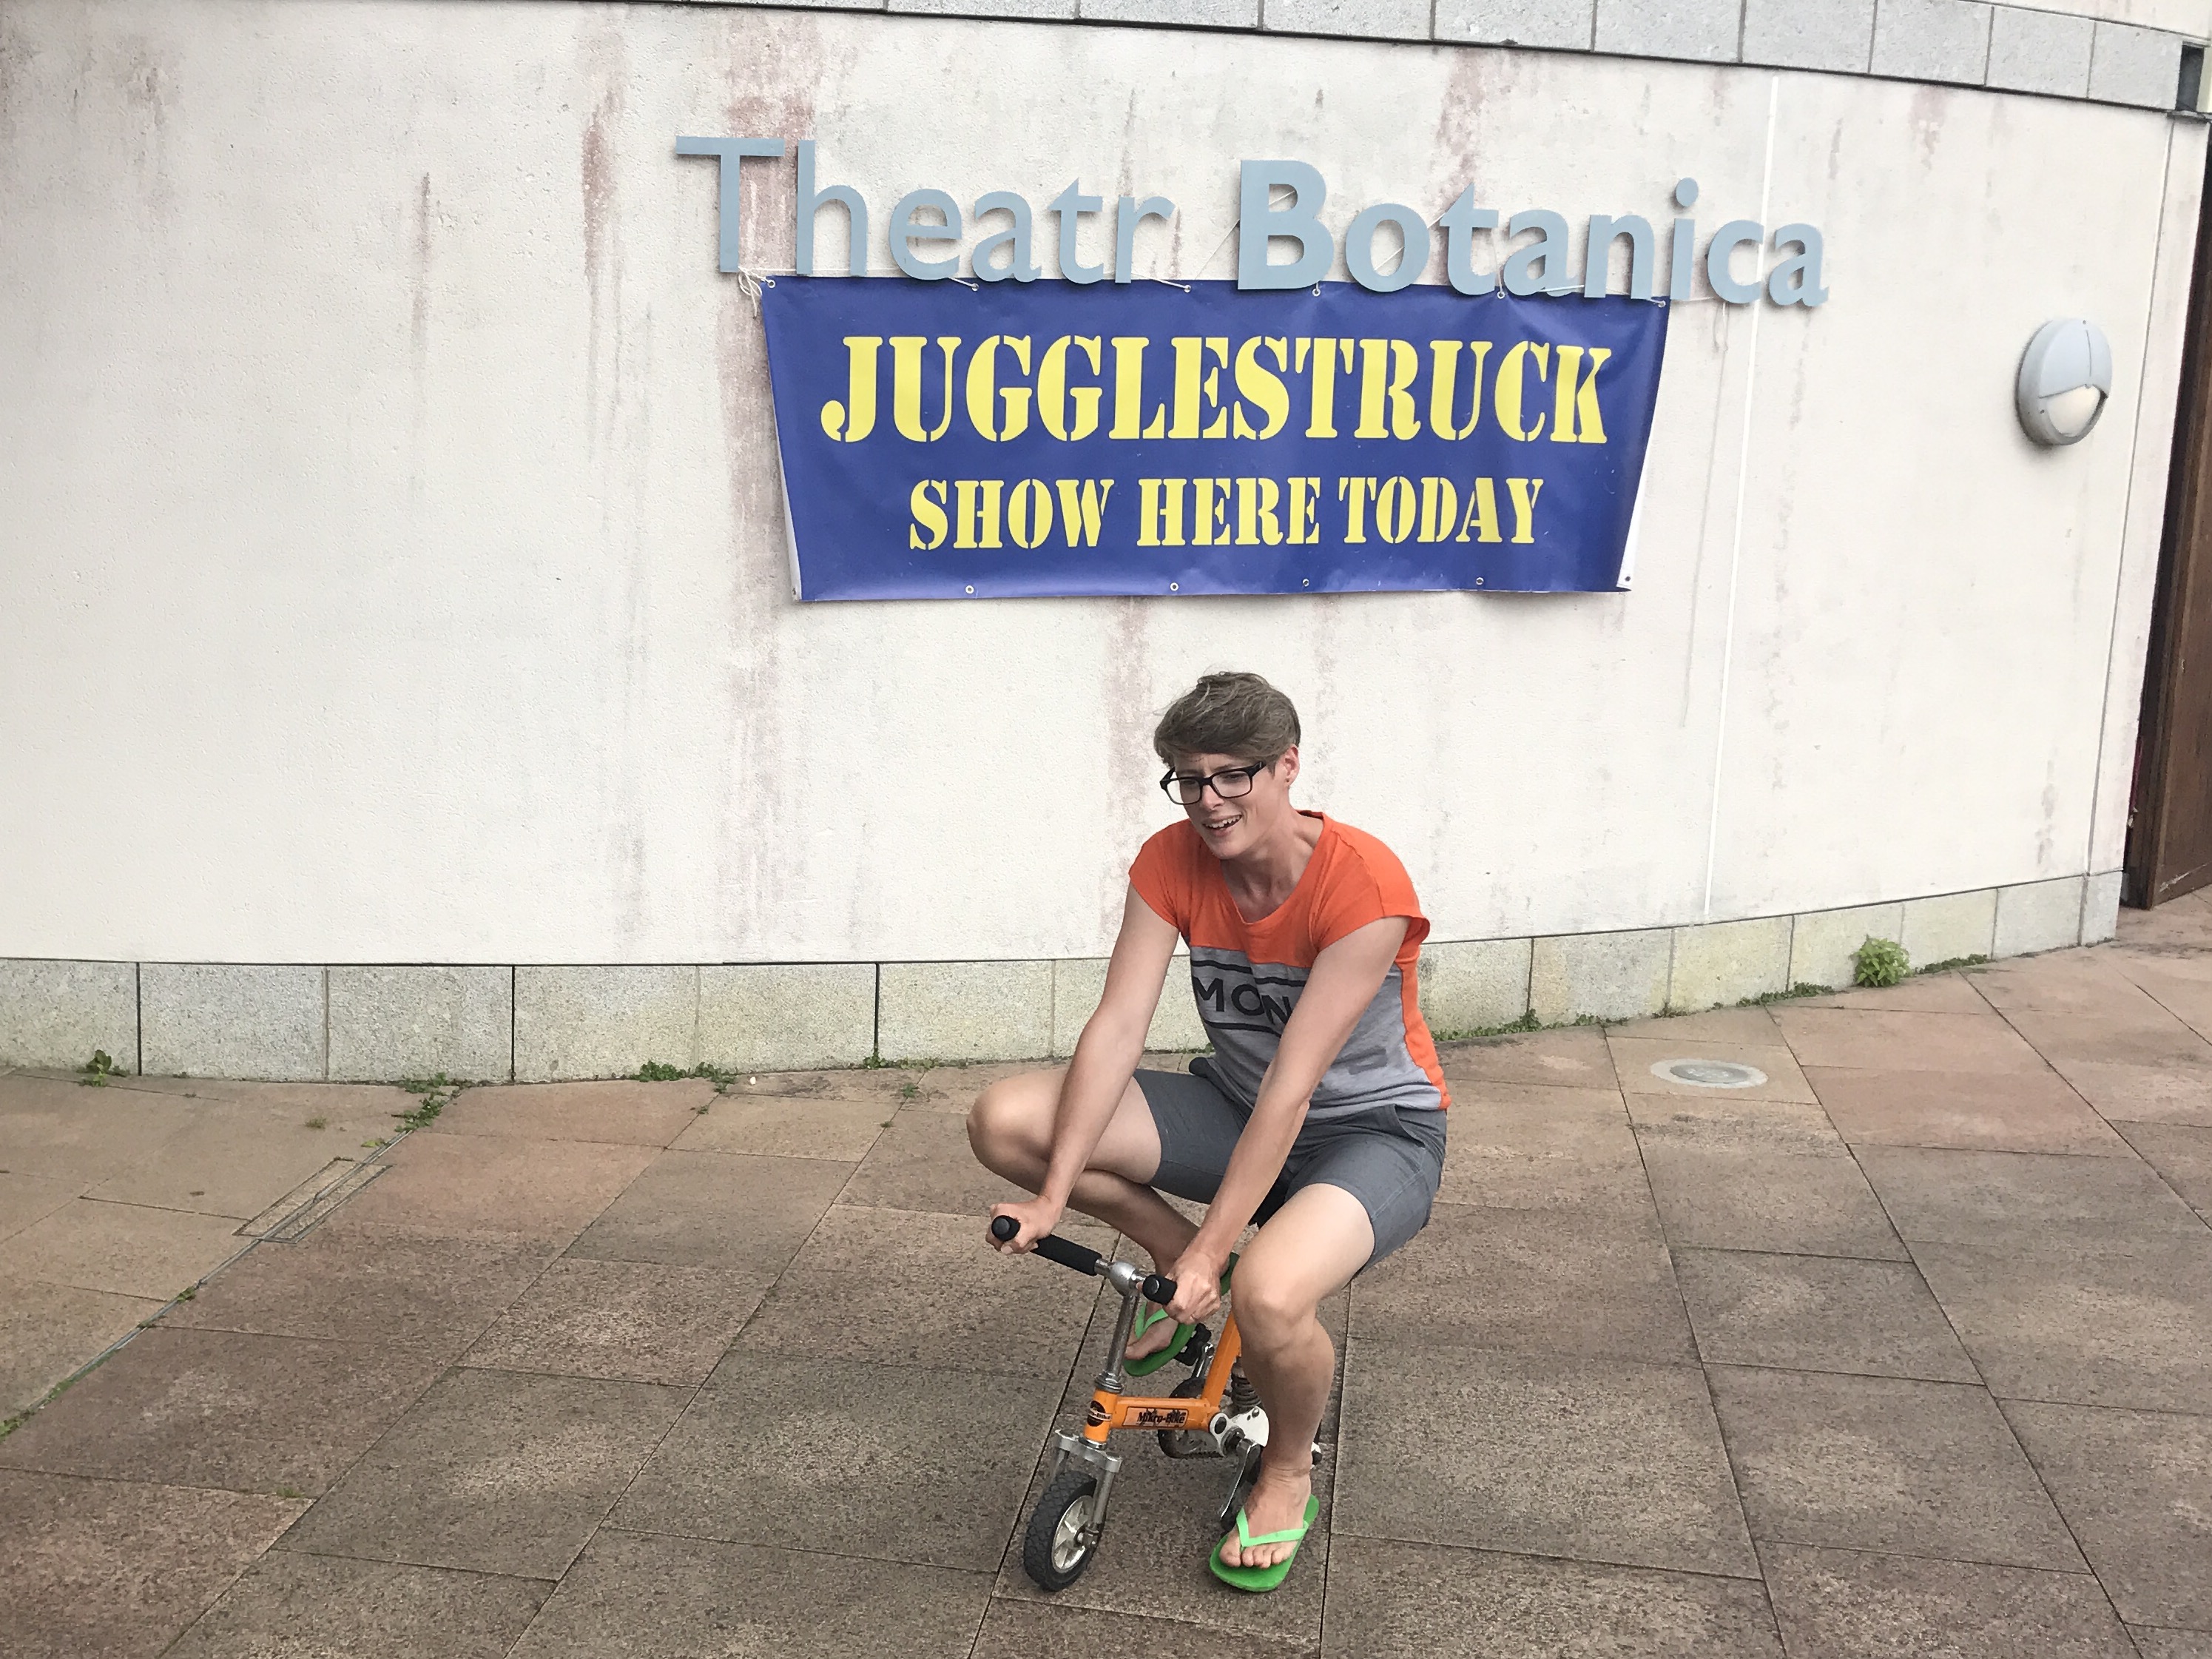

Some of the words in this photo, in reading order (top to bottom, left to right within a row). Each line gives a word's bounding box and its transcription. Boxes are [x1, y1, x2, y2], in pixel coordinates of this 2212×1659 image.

[676, 135, 1175, 284] Theatr
[1238, 159, 1829, 307] Botanica
[820, 334, 1611, 444] JUGGLESTRUCK
[909, 479, 1114, 550] SHOW
[1137, 477, 1321, 546] HERE
[1338, 476, 1544, 545] TODAY
